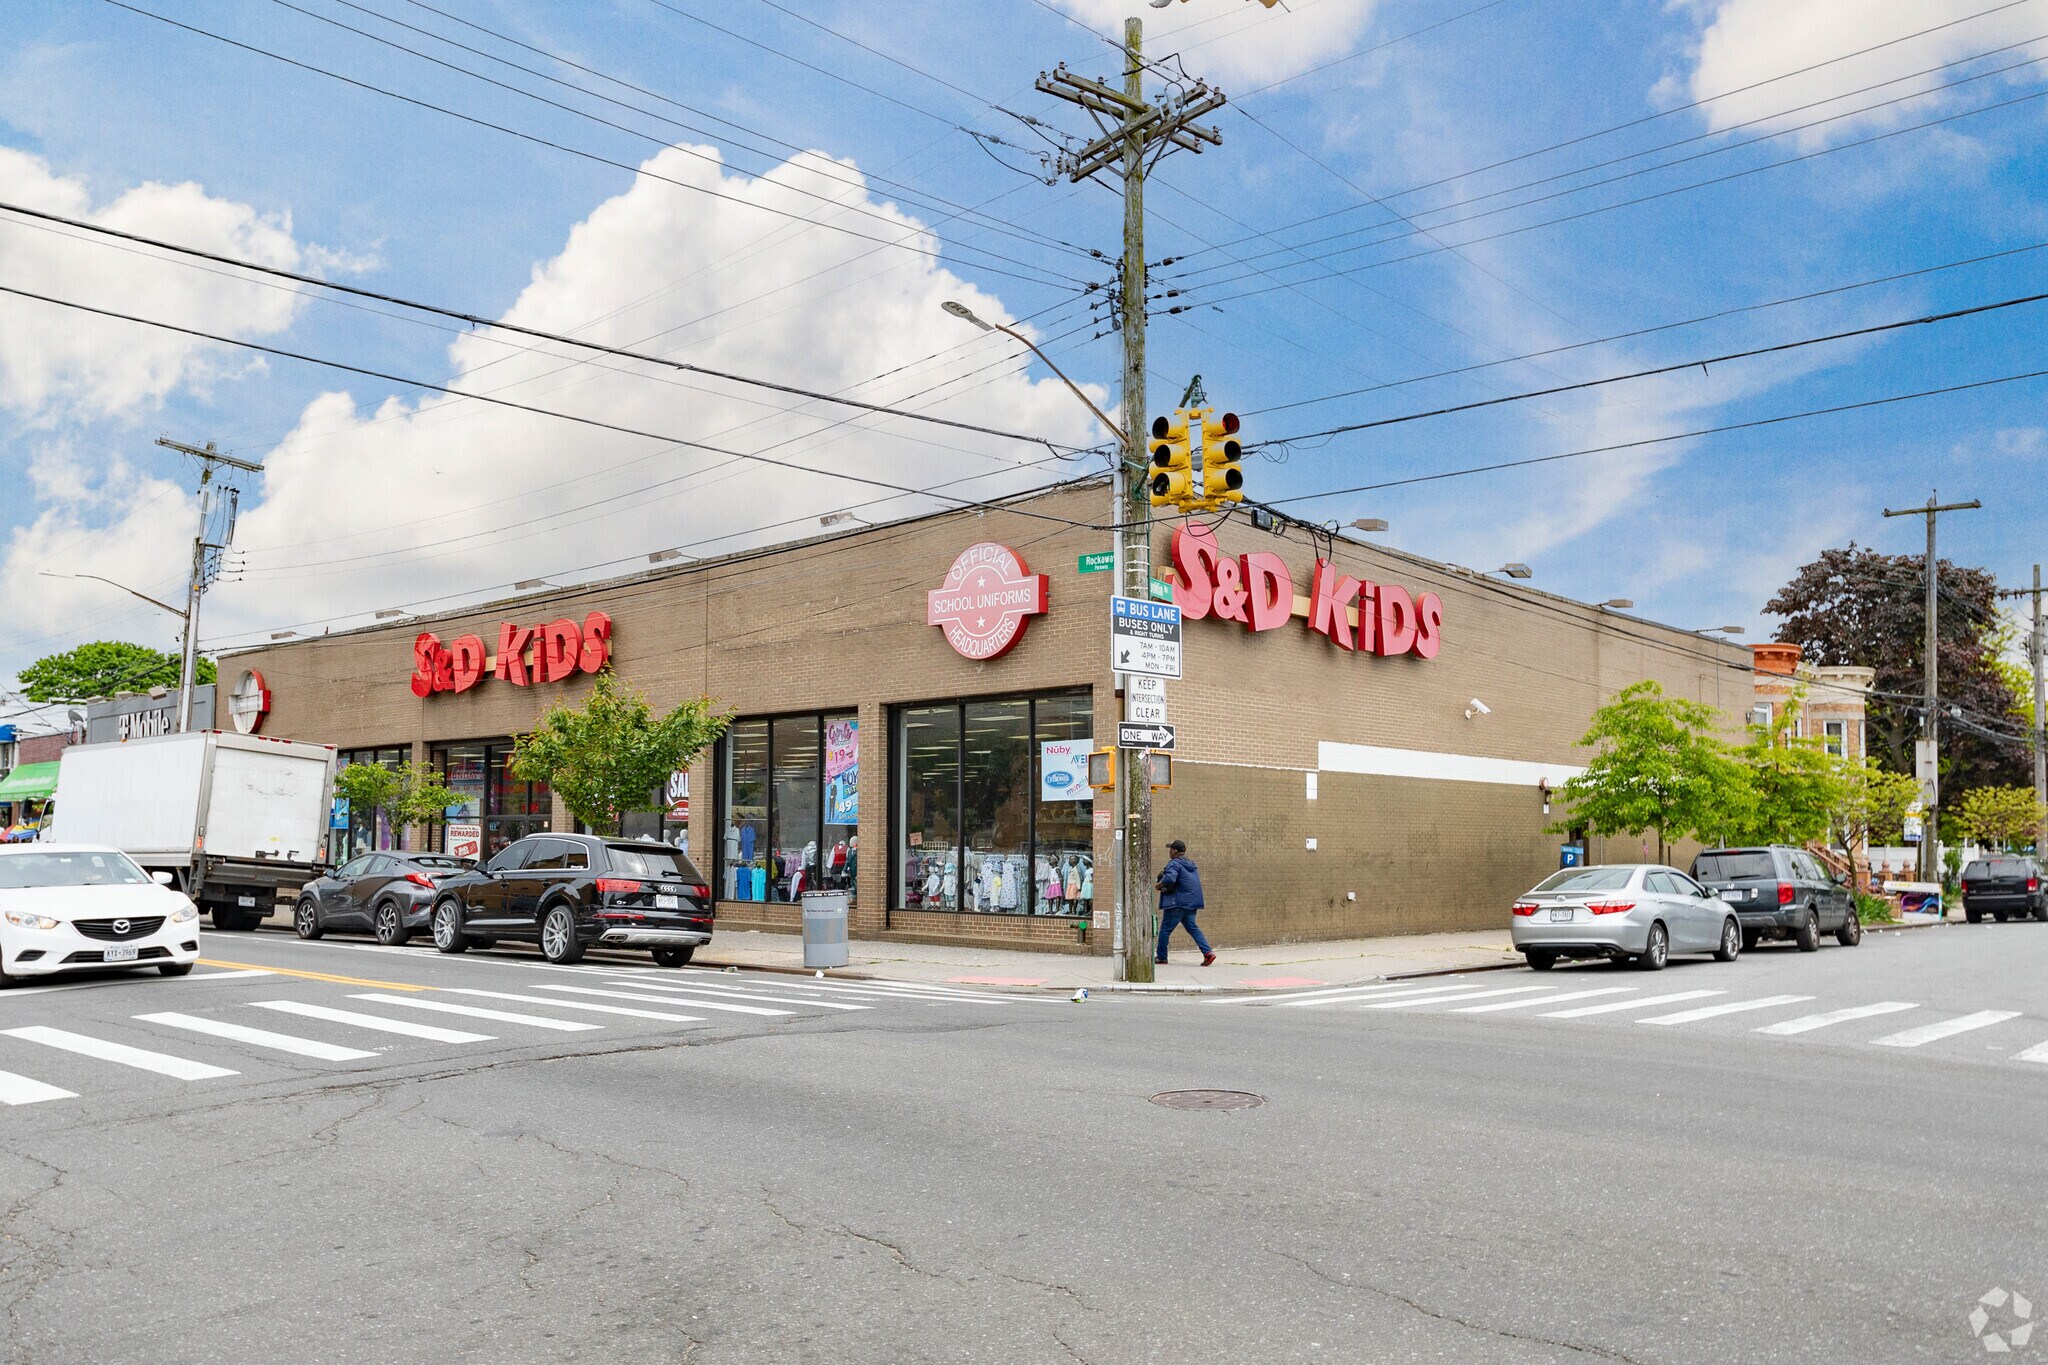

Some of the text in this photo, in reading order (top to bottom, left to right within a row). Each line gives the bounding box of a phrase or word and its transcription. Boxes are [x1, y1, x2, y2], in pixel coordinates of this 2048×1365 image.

[951, 546, 1014, 581] OFFICIAL
[1166, 520, 1293, 632] S&D
[934, 588, 1031, 614] SCHOOL UNIFORMS
[1129, 602, 1176, 622] BUS LANE
[1118, 617, 1174, 634] BUSES ONLY
[949, 617, 1016, 656] HEADQUARTERS
[1134, 630, 1148, 638] RIGHT
[1149, 632, 1165, 640] TURNS
[1139, 641, 1153, 650] 7AM
[1159, 644, 1175, 652] 10AM
[1141, 652, 1156, 660] 4PM
[1162, 654, 1176, 662] 7PM
[411, 632, 486, 698] S&D
[1145, 662, 1160, 670] MON
[1165, 664, 1176, 672] FRI
[1138, 679, 1156, 690] KEEP
[1131, 693, 1165, 704] INTERSECTION
[1135, 707, 1160, 719] CLEAR
[1123, 730, 1169, 741] ONE WAY
[670, 772, 689, 797] SAL
[450, 829, 480, 838] REWARDED
[1566, 853, 1574, 864] P
